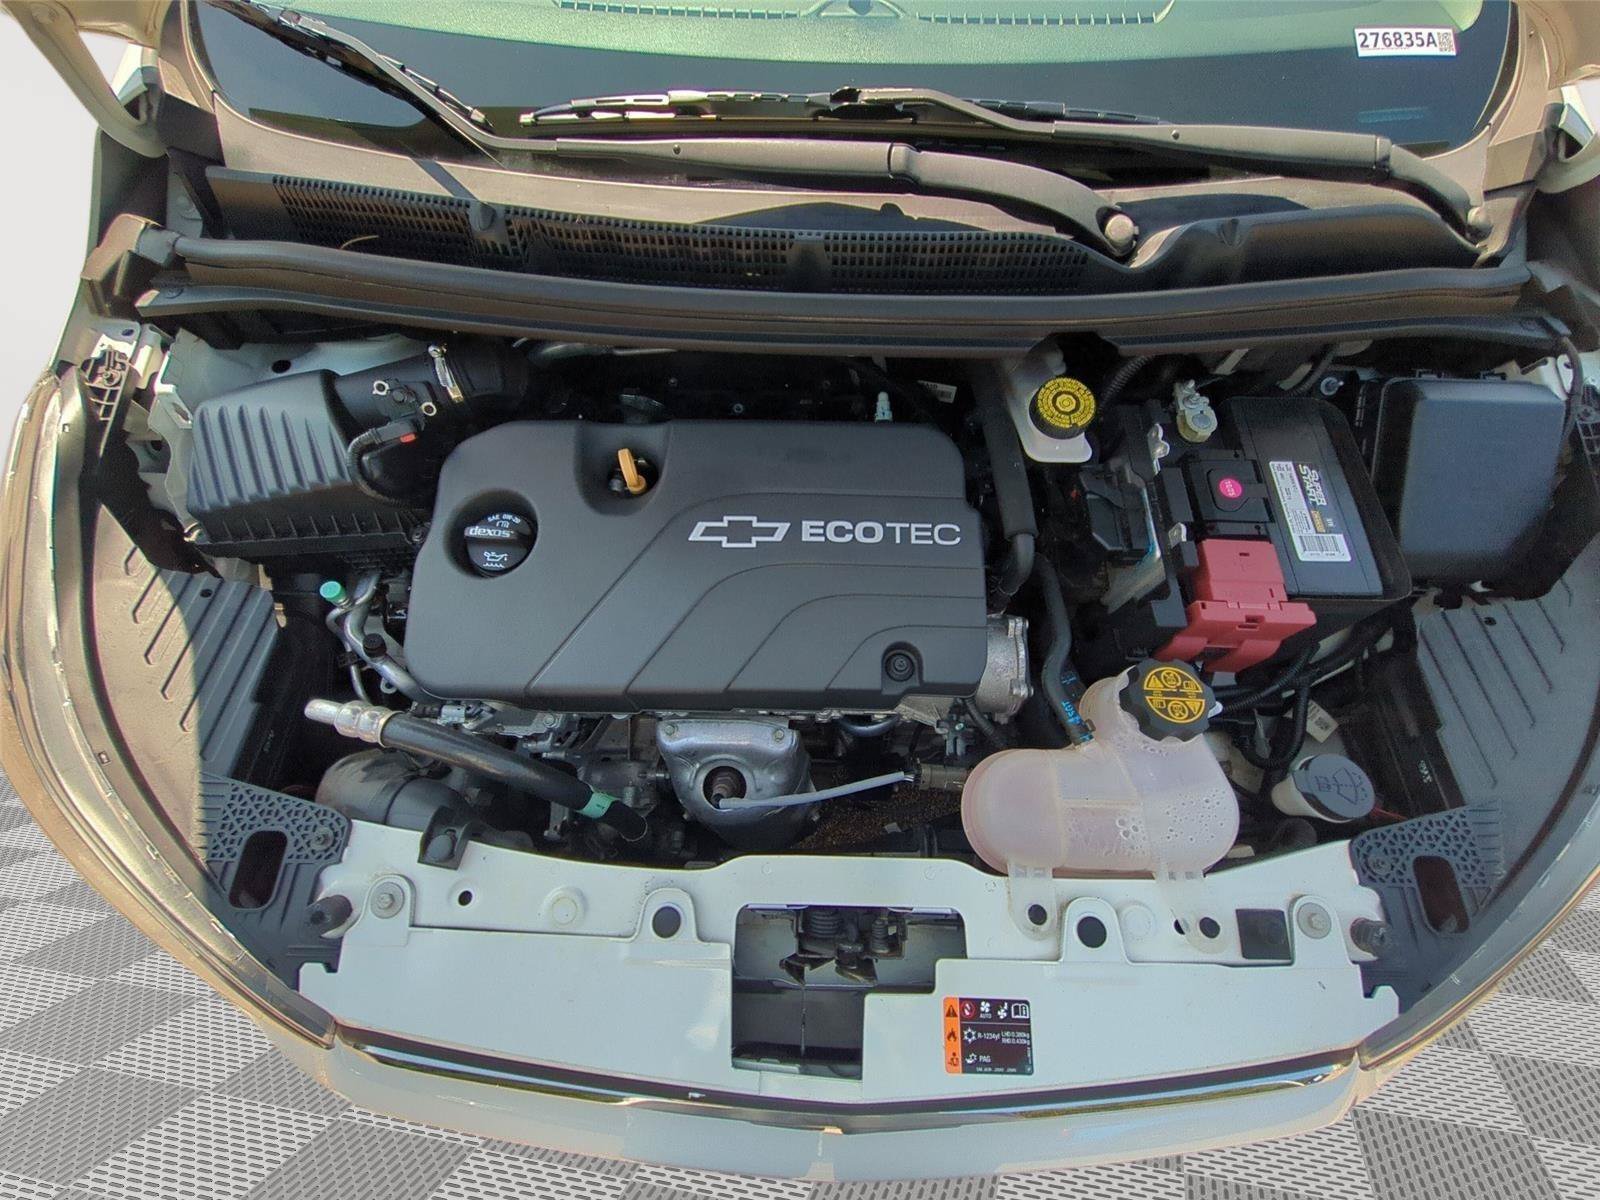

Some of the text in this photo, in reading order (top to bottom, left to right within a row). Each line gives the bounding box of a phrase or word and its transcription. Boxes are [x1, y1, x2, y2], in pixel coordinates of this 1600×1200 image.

[1358, 31, 1437, 48] 276835A
[1298, 463, 1317, 505] START
[1310, 469, 1327, 506] SUPER
[469, 526, 511, 538] dexos
[801, 520, 961, 546] ECOTEC
